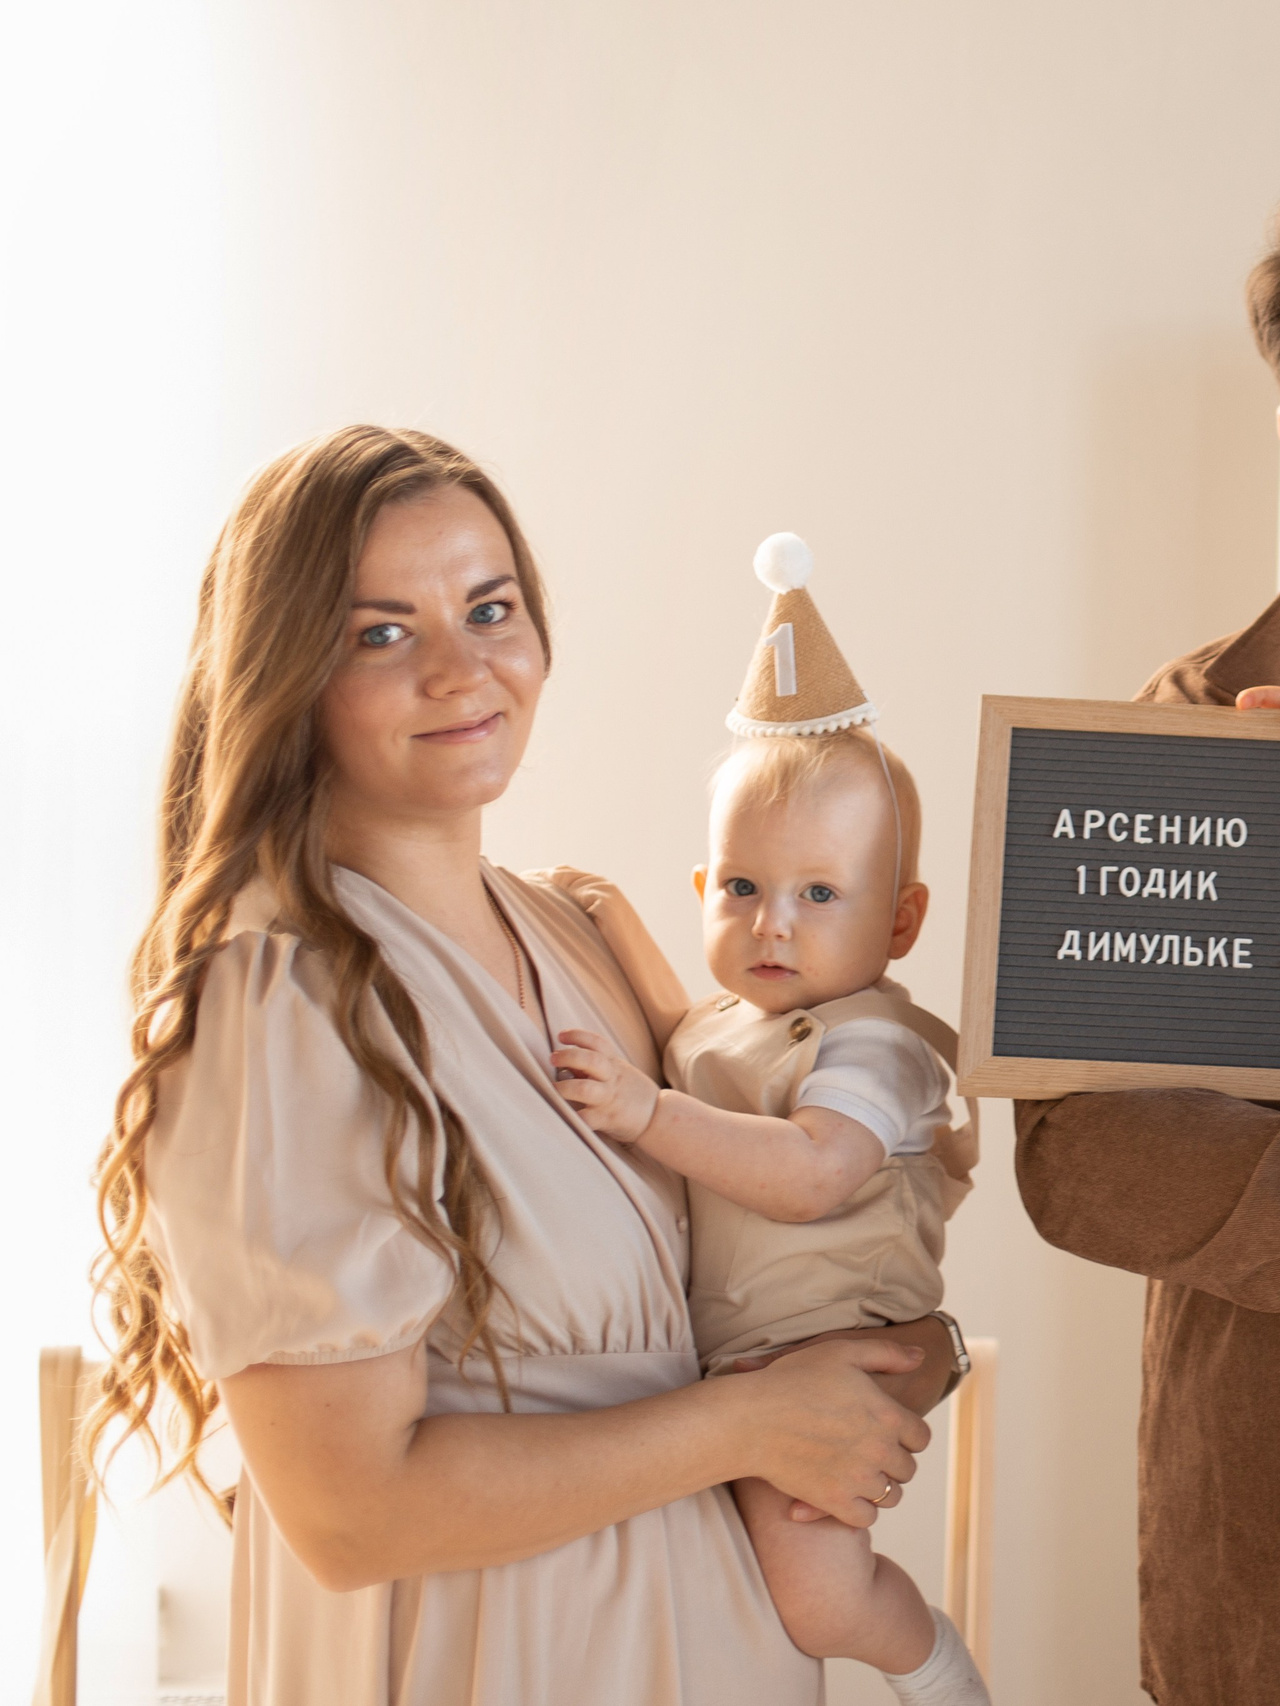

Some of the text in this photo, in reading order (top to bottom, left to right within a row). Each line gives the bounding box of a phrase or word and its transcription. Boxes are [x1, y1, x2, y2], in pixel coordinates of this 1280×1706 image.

[764, 622, 797, 697] 1
[1053, 809, 1247, 847] АРСЕНИЮ
[1077, 865, 1217, 901] 1 ГОДИК
[1058, 930, 1252, 968] ДИМУЛЬКЕ
